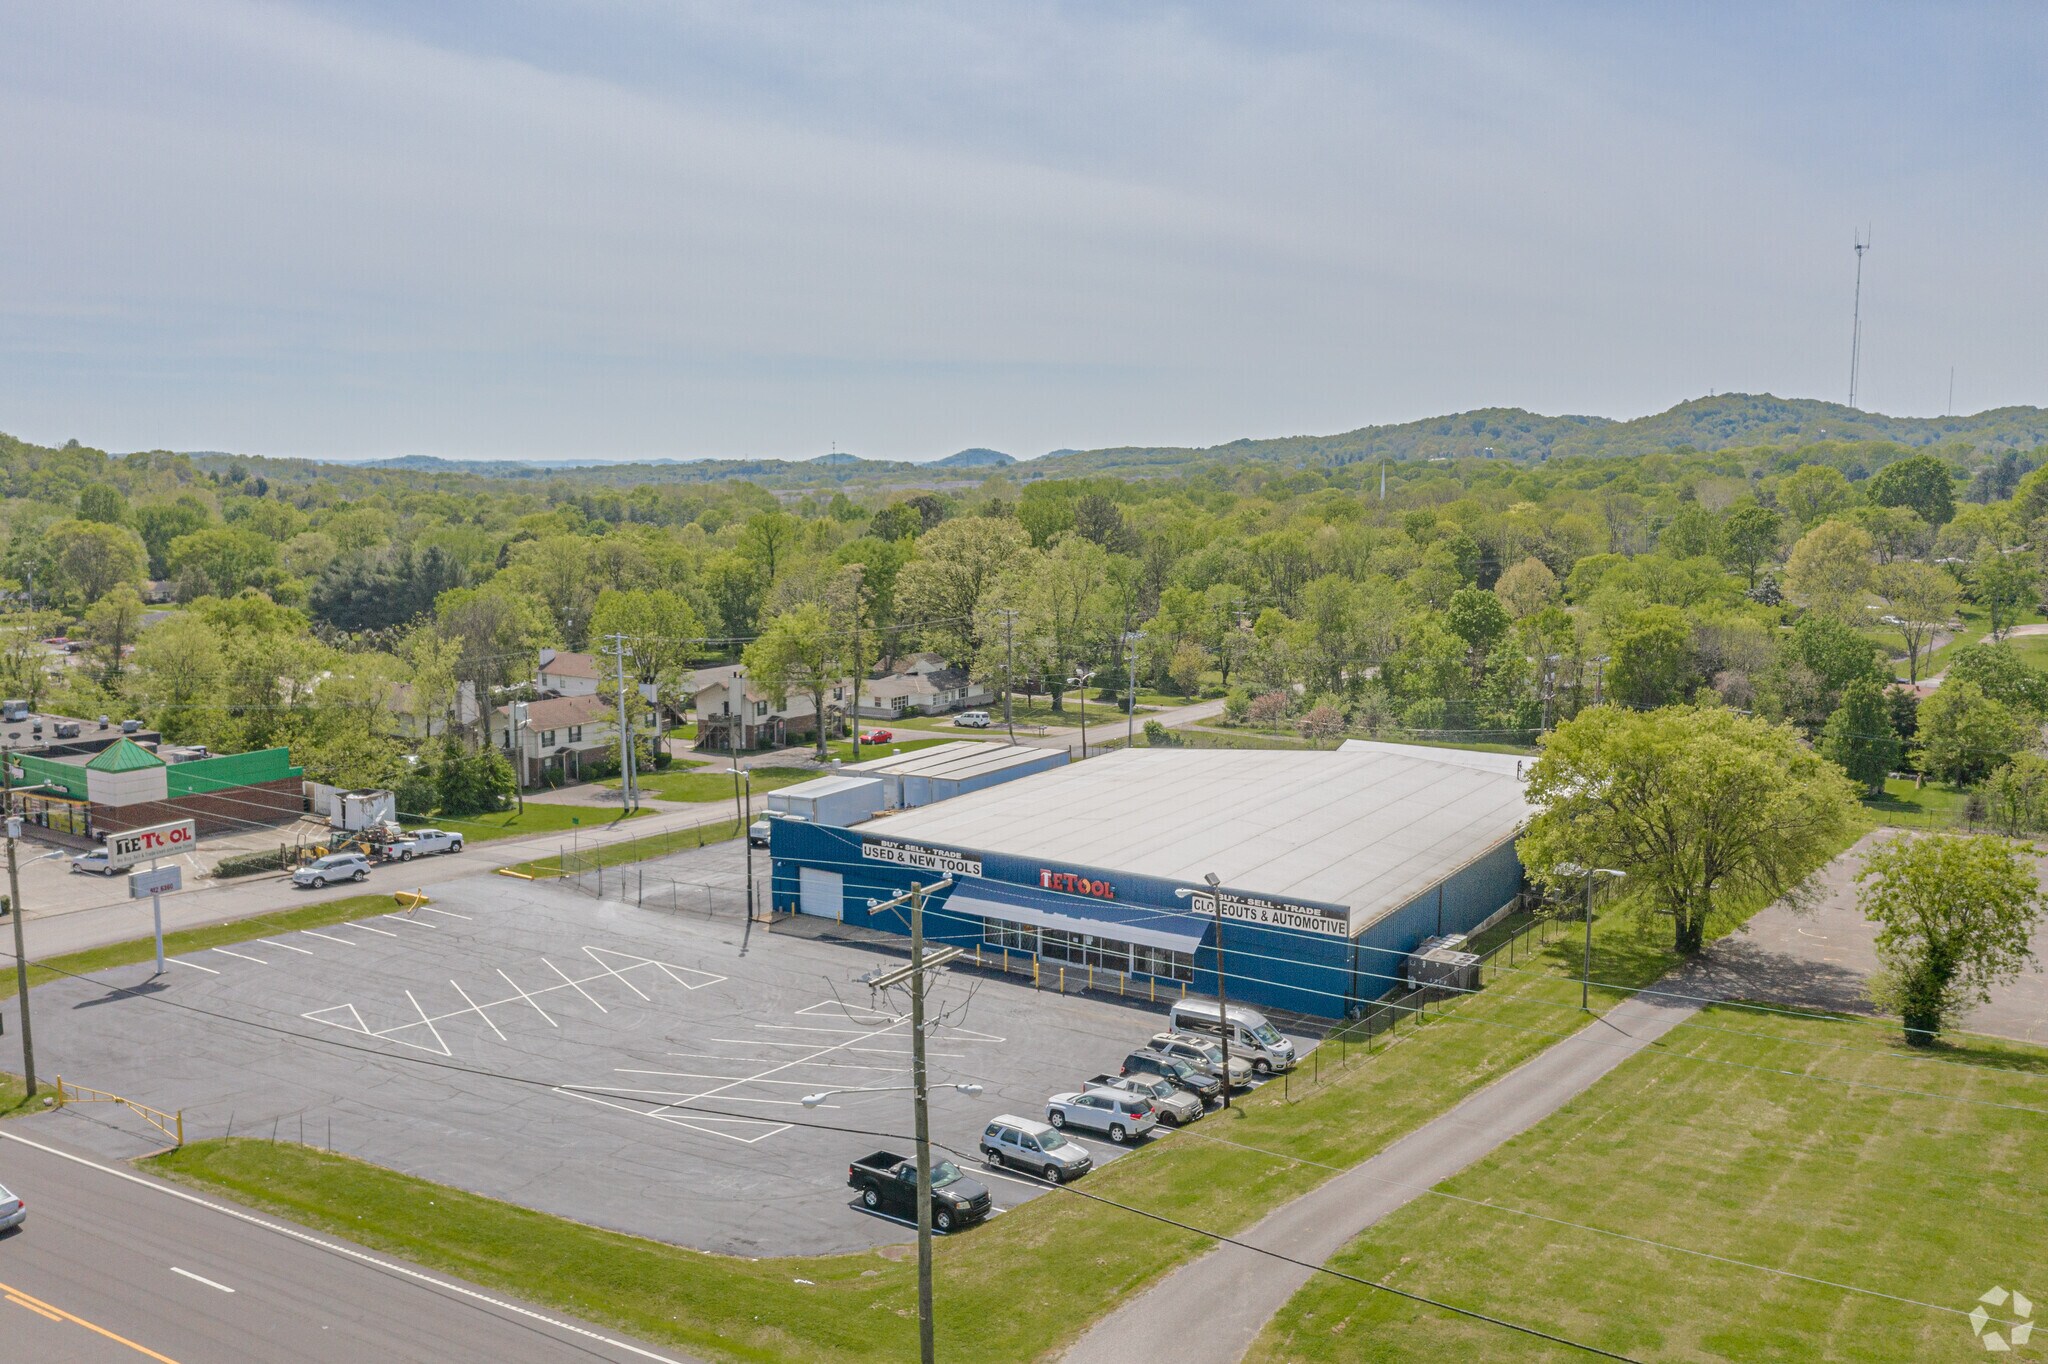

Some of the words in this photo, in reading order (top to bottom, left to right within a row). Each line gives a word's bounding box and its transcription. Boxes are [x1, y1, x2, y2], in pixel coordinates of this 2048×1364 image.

[864, 846, 894, 860] USED
[897, 851, 905, 862] &
[909, 854, 936, 867] NEW
[940, 858, 980, 875] TOOLS
[881, 840, 899, 849] BUY
[905, 844, 926, 853] SELL
[932, 848, 962, 859] TRADE
[1194, 899, 1257, 920] CLOEOUTS
[1260, 910, 1268, 922] &
[1272, 911, 1345, 935] AUTOMOTIVE
[1247, 898, 1274, 909] SELL
[1283, 903, 1322, 916] TRADE
